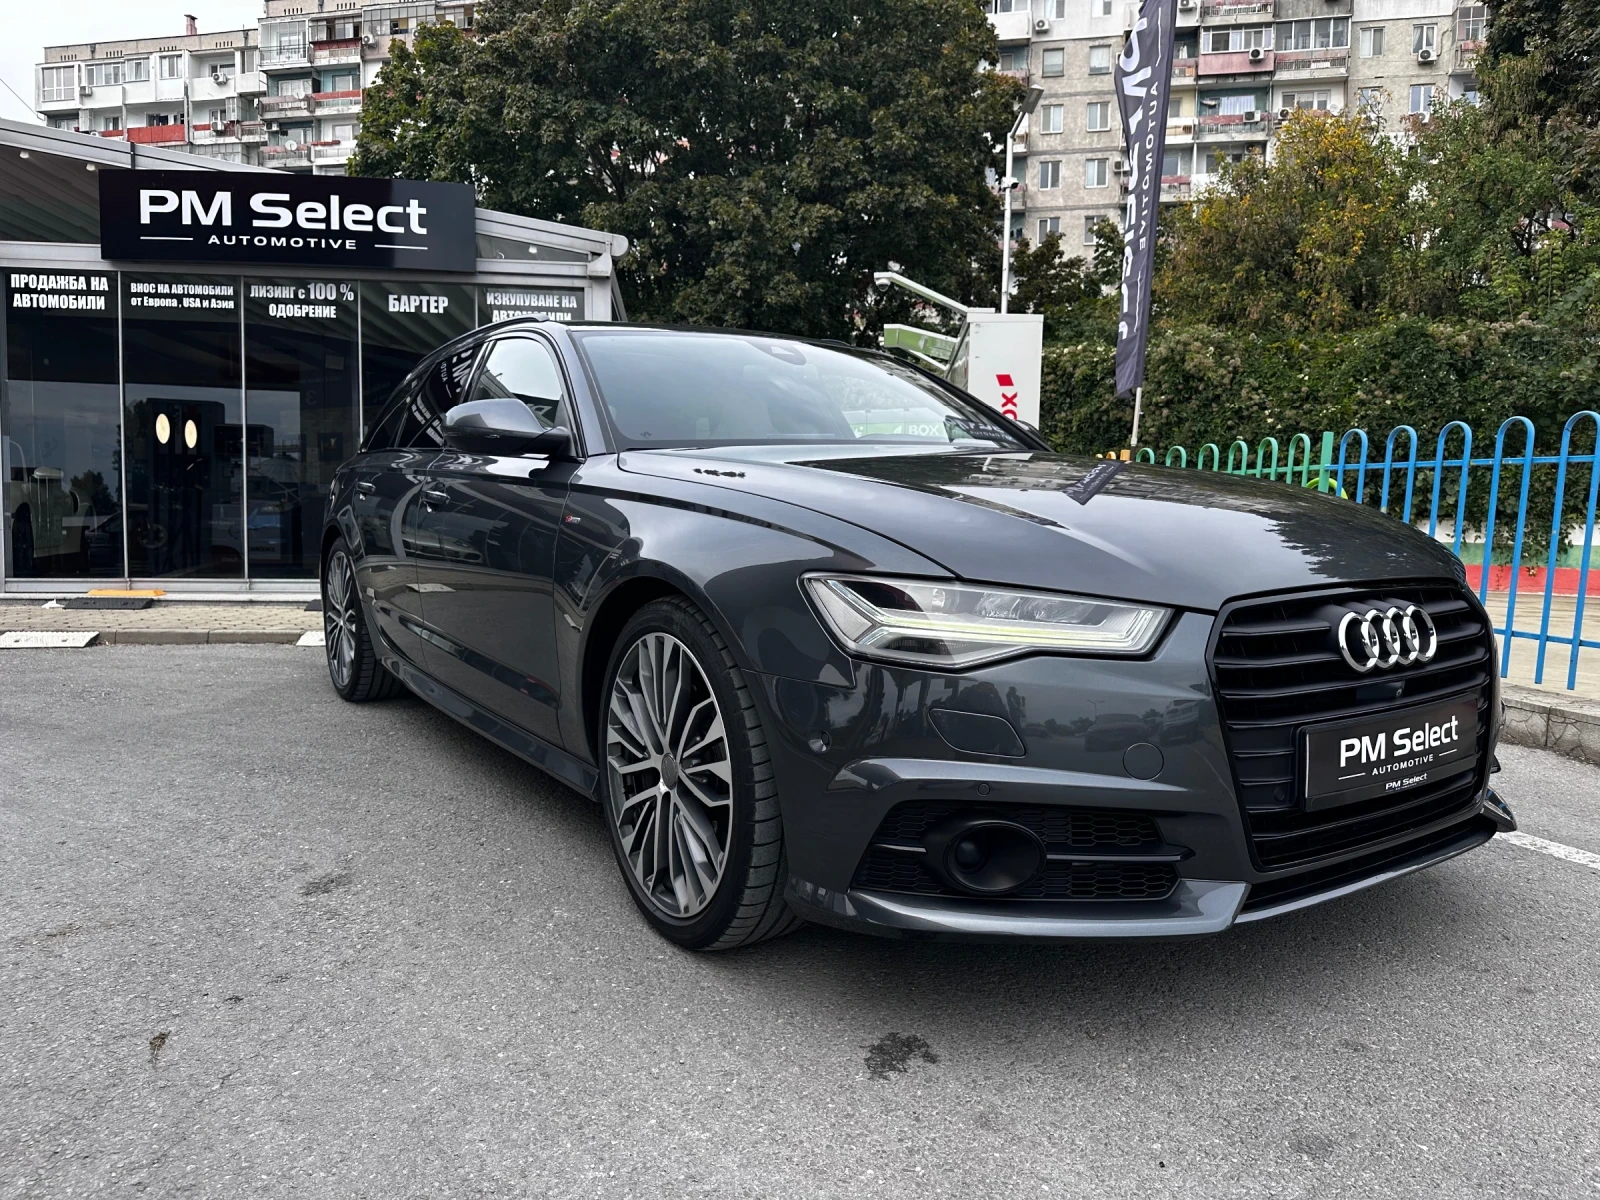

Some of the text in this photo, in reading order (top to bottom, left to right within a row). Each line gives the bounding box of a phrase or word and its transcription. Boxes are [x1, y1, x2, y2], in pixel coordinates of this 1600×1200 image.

[139, 189, 428, 235] PM Select
[208, 234, 357, 250] AUTOMOTIVE
[10, 273, 109, 292] ПРОДАЖБА НА
[130, 282, 234, 296] ВНОС НА АВТОМОБИЛИ
[249, 284, 296, 299] ЛИЗИНГ
[298, 288, 306, 299] с
[307, 282, 337, 300] 100
[12, 293, 106, 310] АВТОМОБИЛИ
[130, 297, 142, 307] от
[143, 296, 177, 308] Европа
[183, 296, 201, 308] USA
[202, 299, 209, 308] и
[210, 298, 235, 310] Азия
[388, 294, 449, 314] БАРТЕР
[486, 292, 578, 309] ИЗКУПУВАНЕ НА
[268, 303, 337, 319] ОДОБРЕНИЕ
[492, 309, 572, 322] АВТОИЛИ
[1340, 714, 1459, 768] PM Select
[1372, 753, 1434, 776] AUTOMOTIVE
[1385, 780, 1401, 790] PM
[1402, 772, 1428, 786] Select
